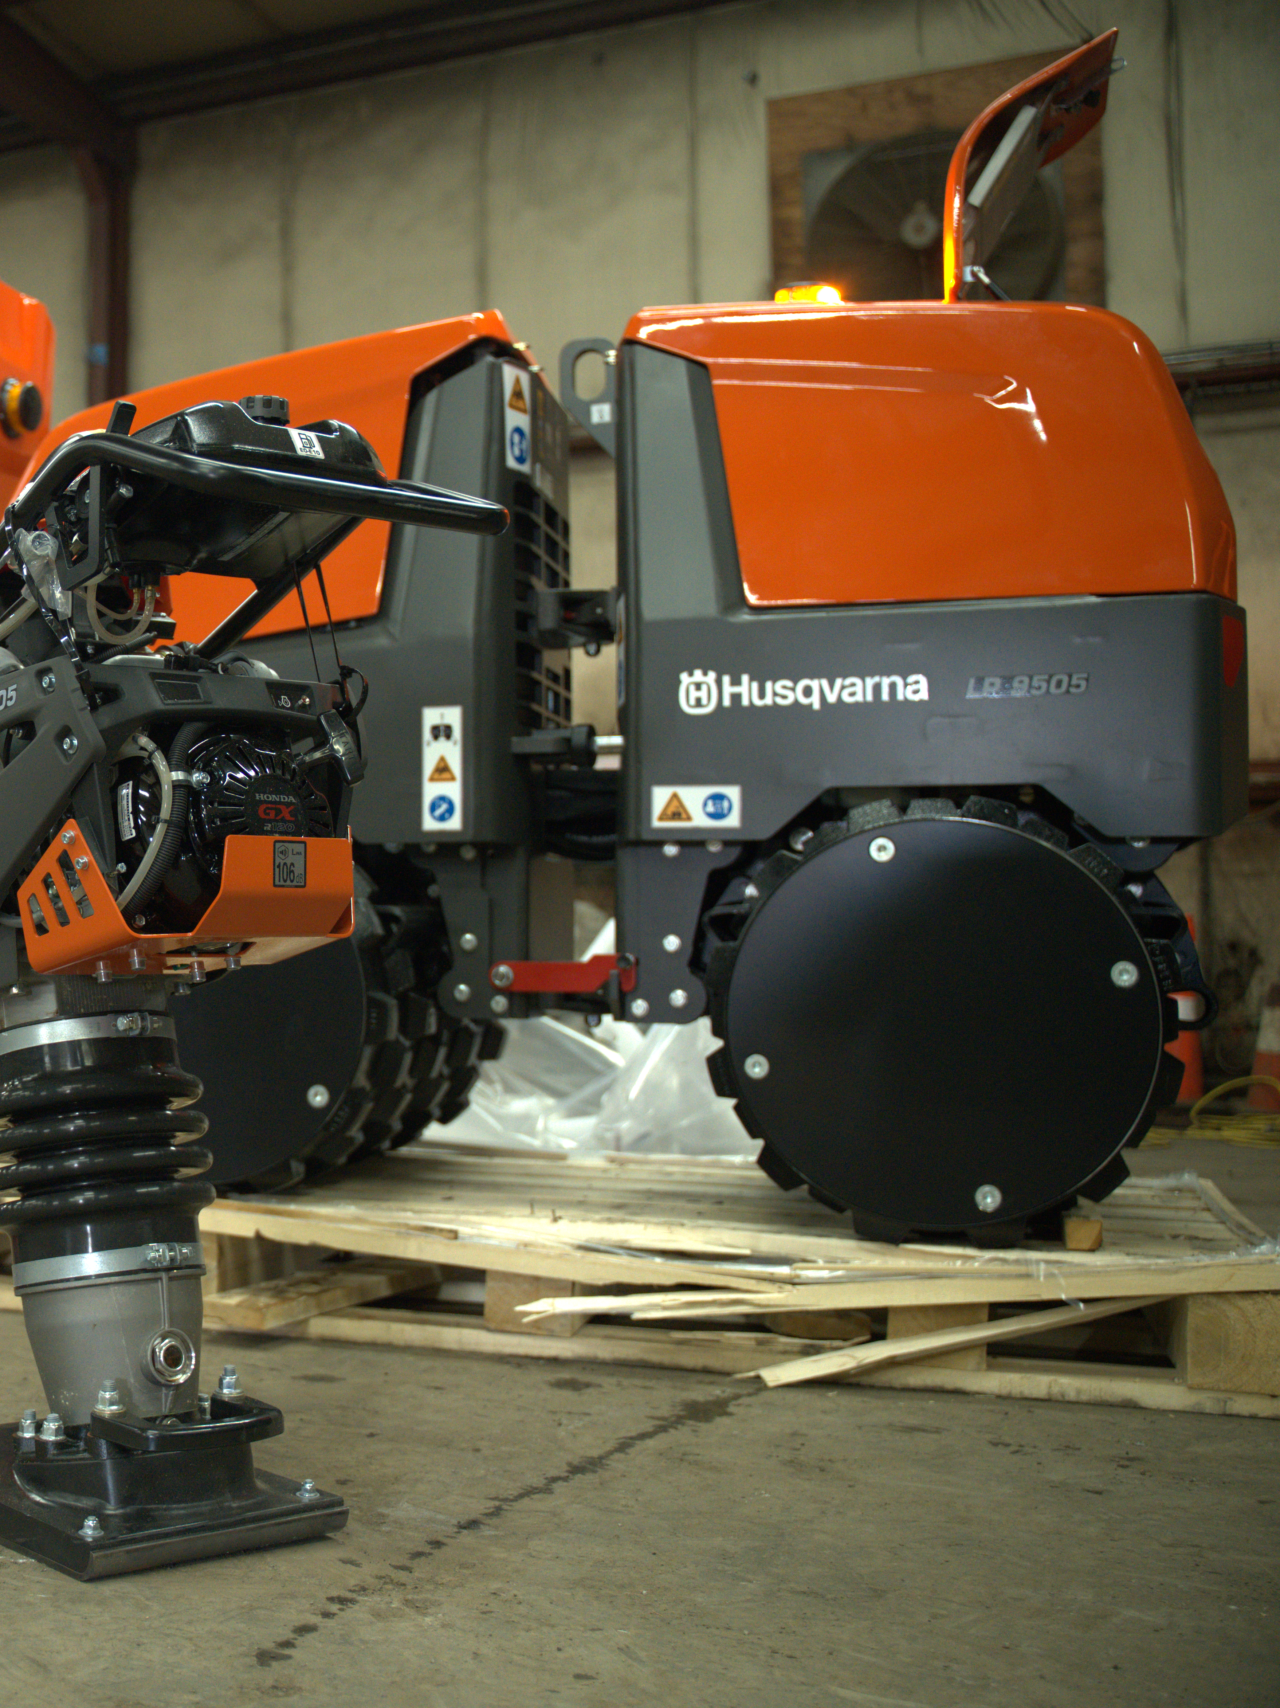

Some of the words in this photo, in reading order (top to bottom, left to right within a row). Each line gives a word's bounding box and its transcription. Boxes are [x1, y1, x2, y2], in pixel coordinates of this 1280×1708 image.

[722, 673, 929, 710] Husqvarna
[1011, 672, 1089, 698] 9505
[255, 793, 297, 803] HONDA
[258, 803, 295, 820] GX
[276, 862, 296, 883] 106
